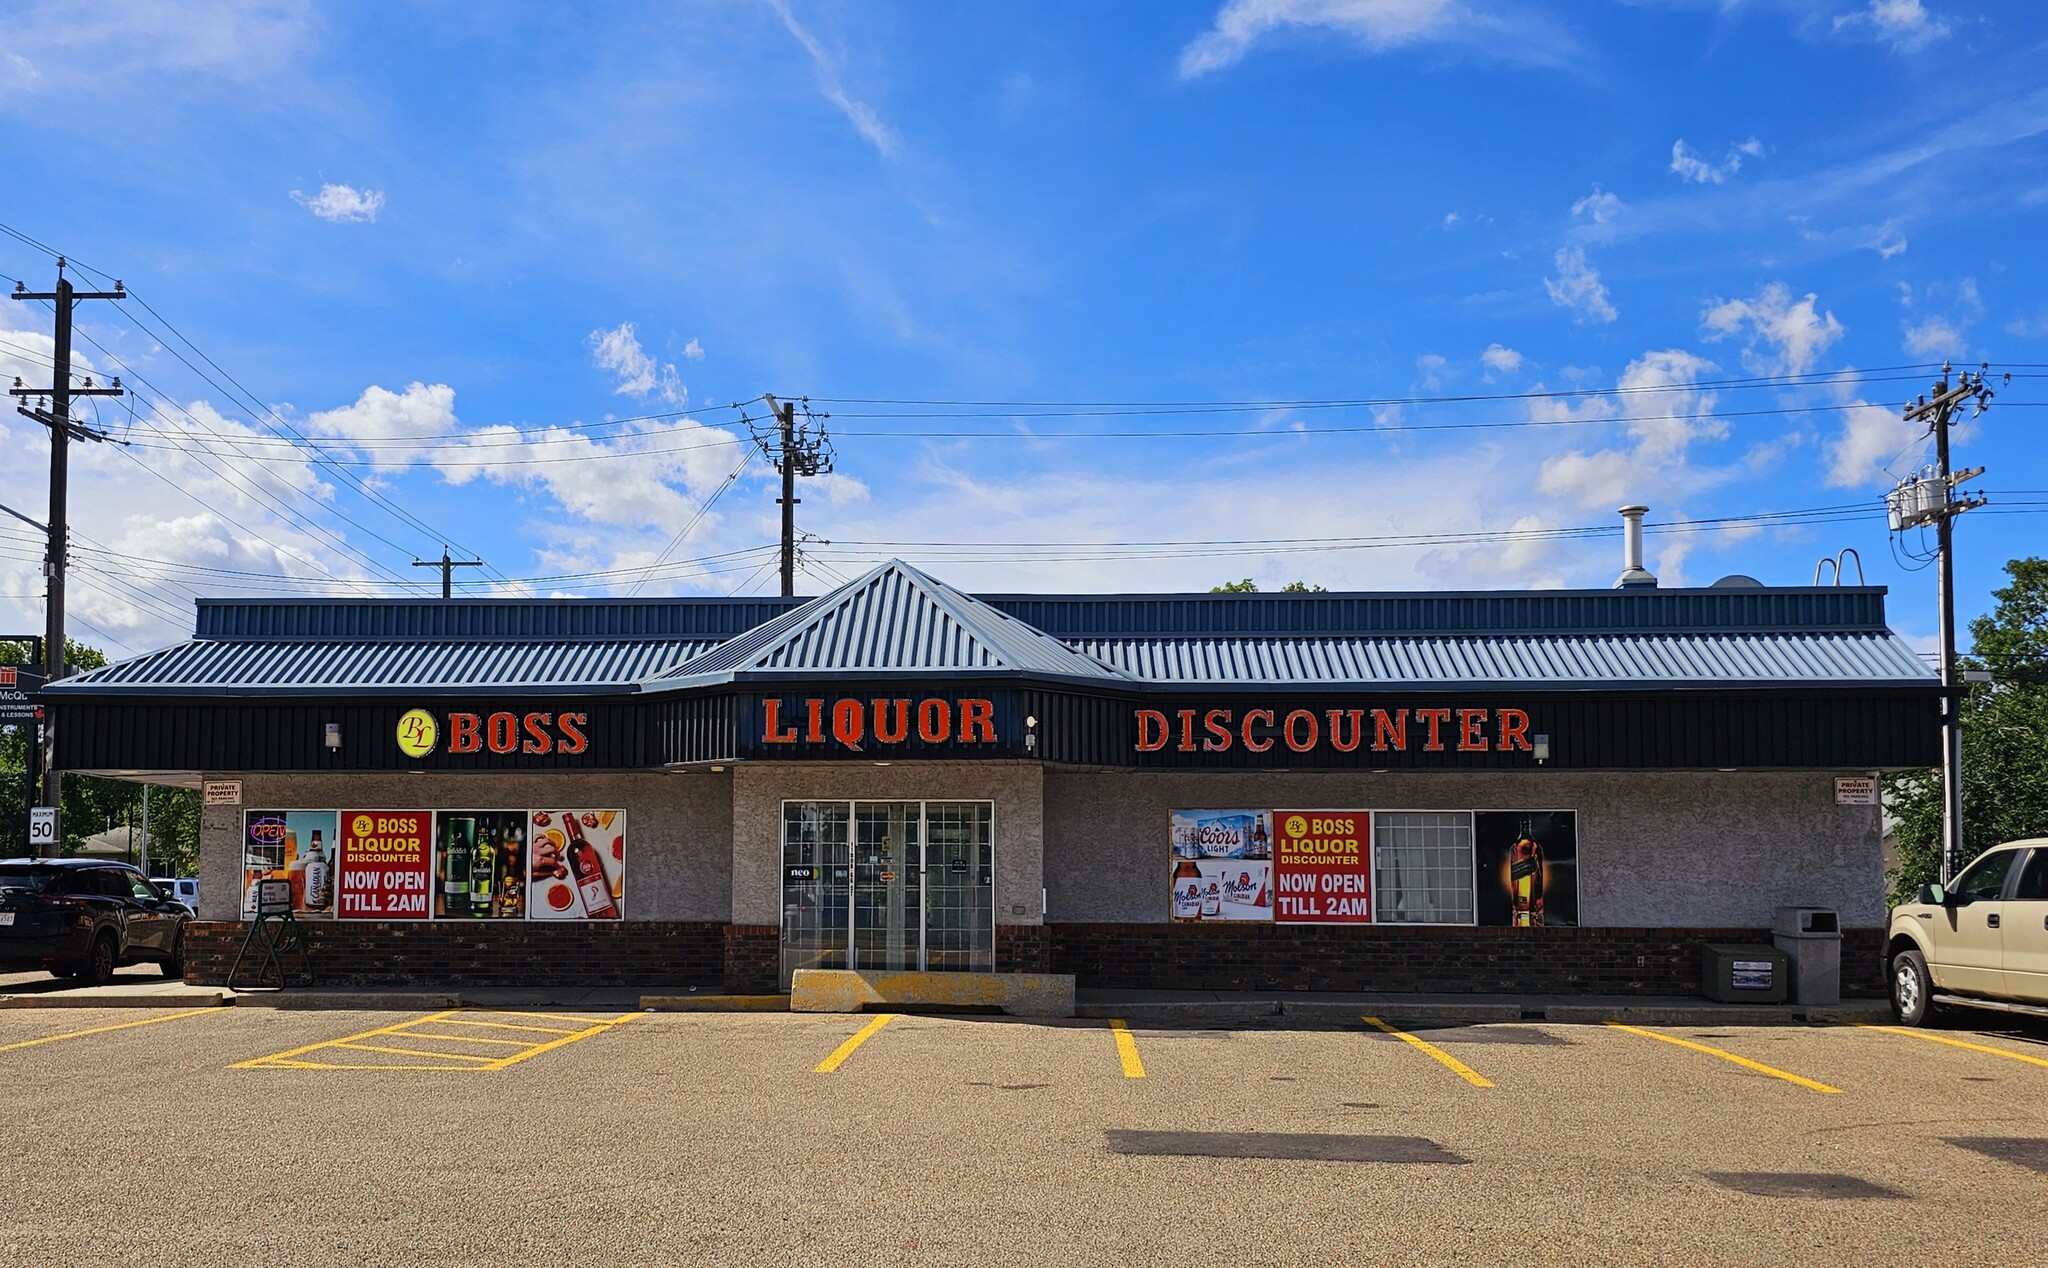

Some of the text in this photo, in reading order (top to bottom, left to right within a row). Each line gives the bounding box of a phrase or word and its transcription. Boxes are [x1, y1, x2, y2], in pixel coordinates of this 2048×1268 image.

[448, 711, 589, 755] BOSS
[761, 698, 998, 751] LIQUOR
[1134, 708, 1532, 752] DISCOUNTER
[32, 821, 52, 838] 50
[253, 824, 287, 837] OPEN
[378, 818, 418, 834] BOSS
[1312, 818, 1355, 835] BOSS
[1200, 826, 1240, 845] Coors
[347, 838, 421, 853] LIQUOR
[1207, 845, 1229, 853] LIGHT
[1281, 839, 1359, 854] LIQUOR
[347, 854, 420, 863] DISCOUNTER
[1281, 855, 1359, 865] DISCOUNTER
[344, 871, 425, 890] NOW OPEN
[790, 869, 810, 877] neo
[1223, 880, 1257, 897] Molson
[1279, 873, 1365, 893] NOW OPEN
[342, 893, 426, 912] TILL 2AM
[1278, 897, 1367, 915] TILL 2AM
